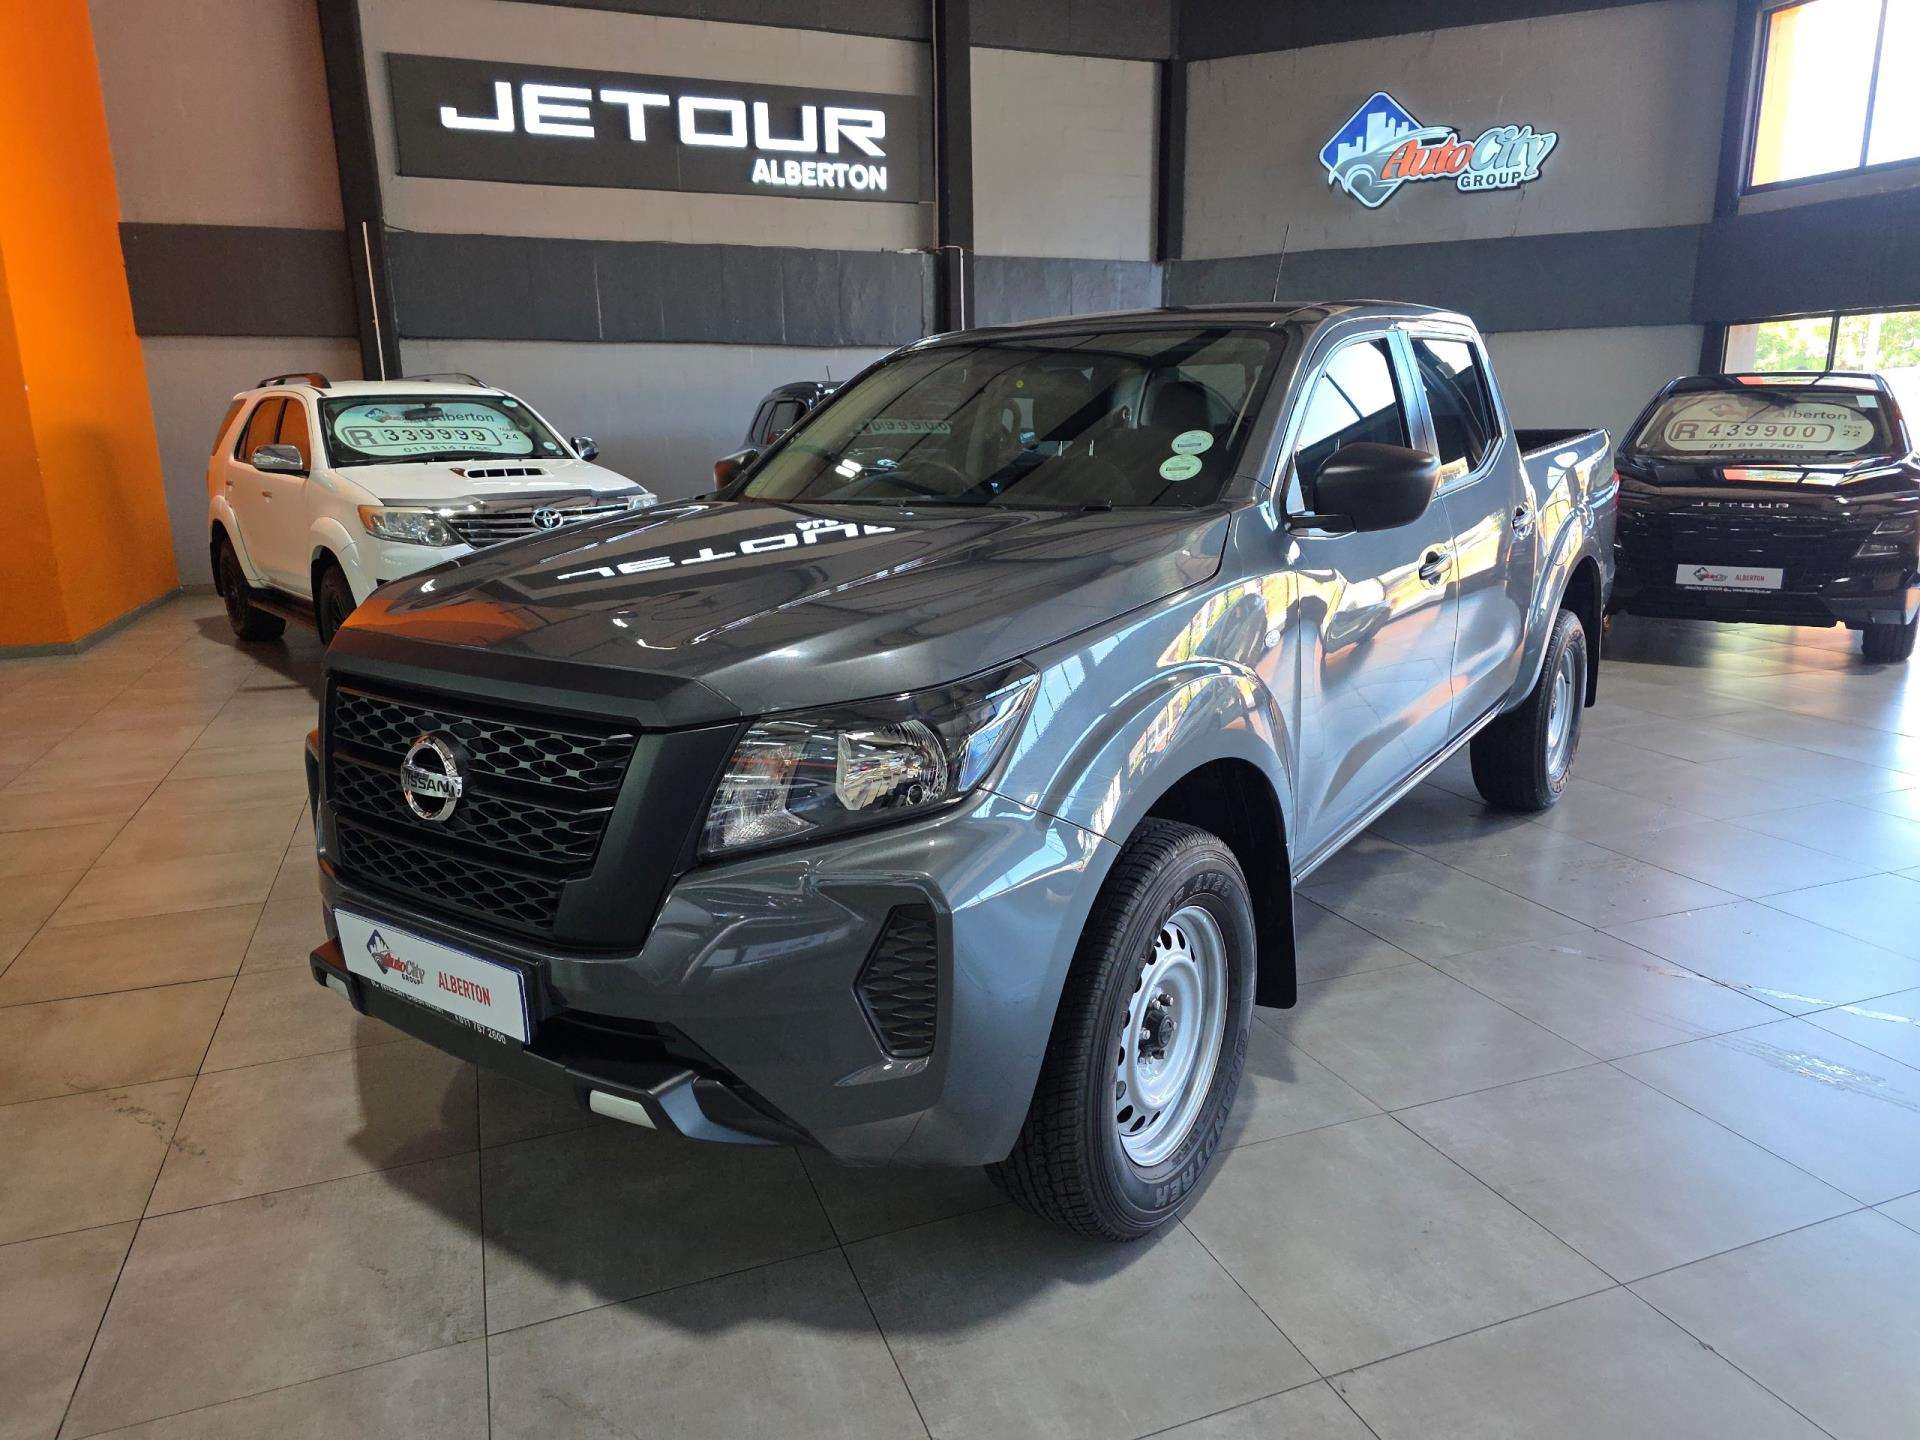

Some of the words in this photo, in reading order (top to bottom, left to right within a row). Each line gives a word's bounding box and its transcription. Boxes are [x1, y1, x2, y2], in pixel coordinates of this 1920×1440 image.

[440, 82, 886, 156] JETOUR
[752, 158, 887, 190] ALBERTON
[1460, 171, 1522, 188] GROUP
[384, 428, 486, 442] 339999
[1707, 424, 1816, 437] 439900
[1691, 501, 1789, 509] JETOUR
[403, 767, 449, 793] NISSAN
[438, 971, 491, 1006] ALBERTON
